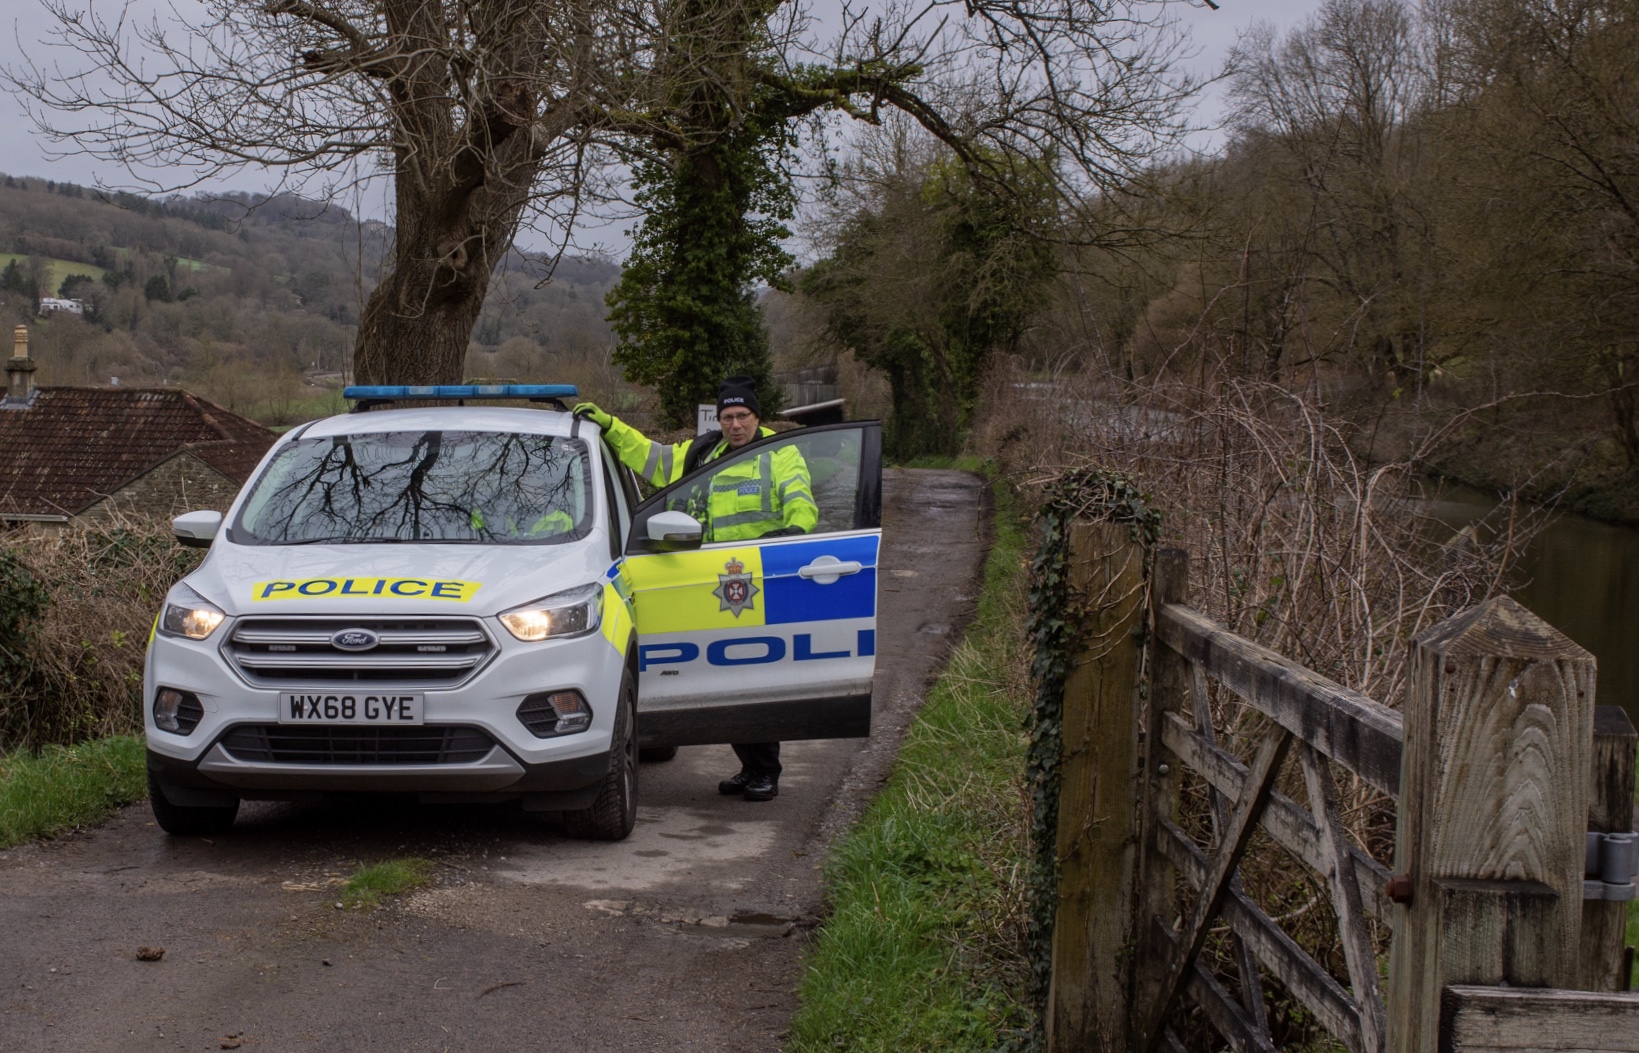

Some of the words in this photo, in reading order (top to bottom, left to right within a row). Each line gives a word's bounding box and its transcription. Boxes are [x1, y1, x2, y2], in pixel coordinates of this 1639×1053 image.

[723, 396, 745, 405] POLICE
[261, 579, 465, 599] POLICE
[341, 633, 368, 645] Ford
[639, 629, 875, 672] POLI
[290, 695, 356, 720] WX68
[364, 696, 414, 721] GYE
